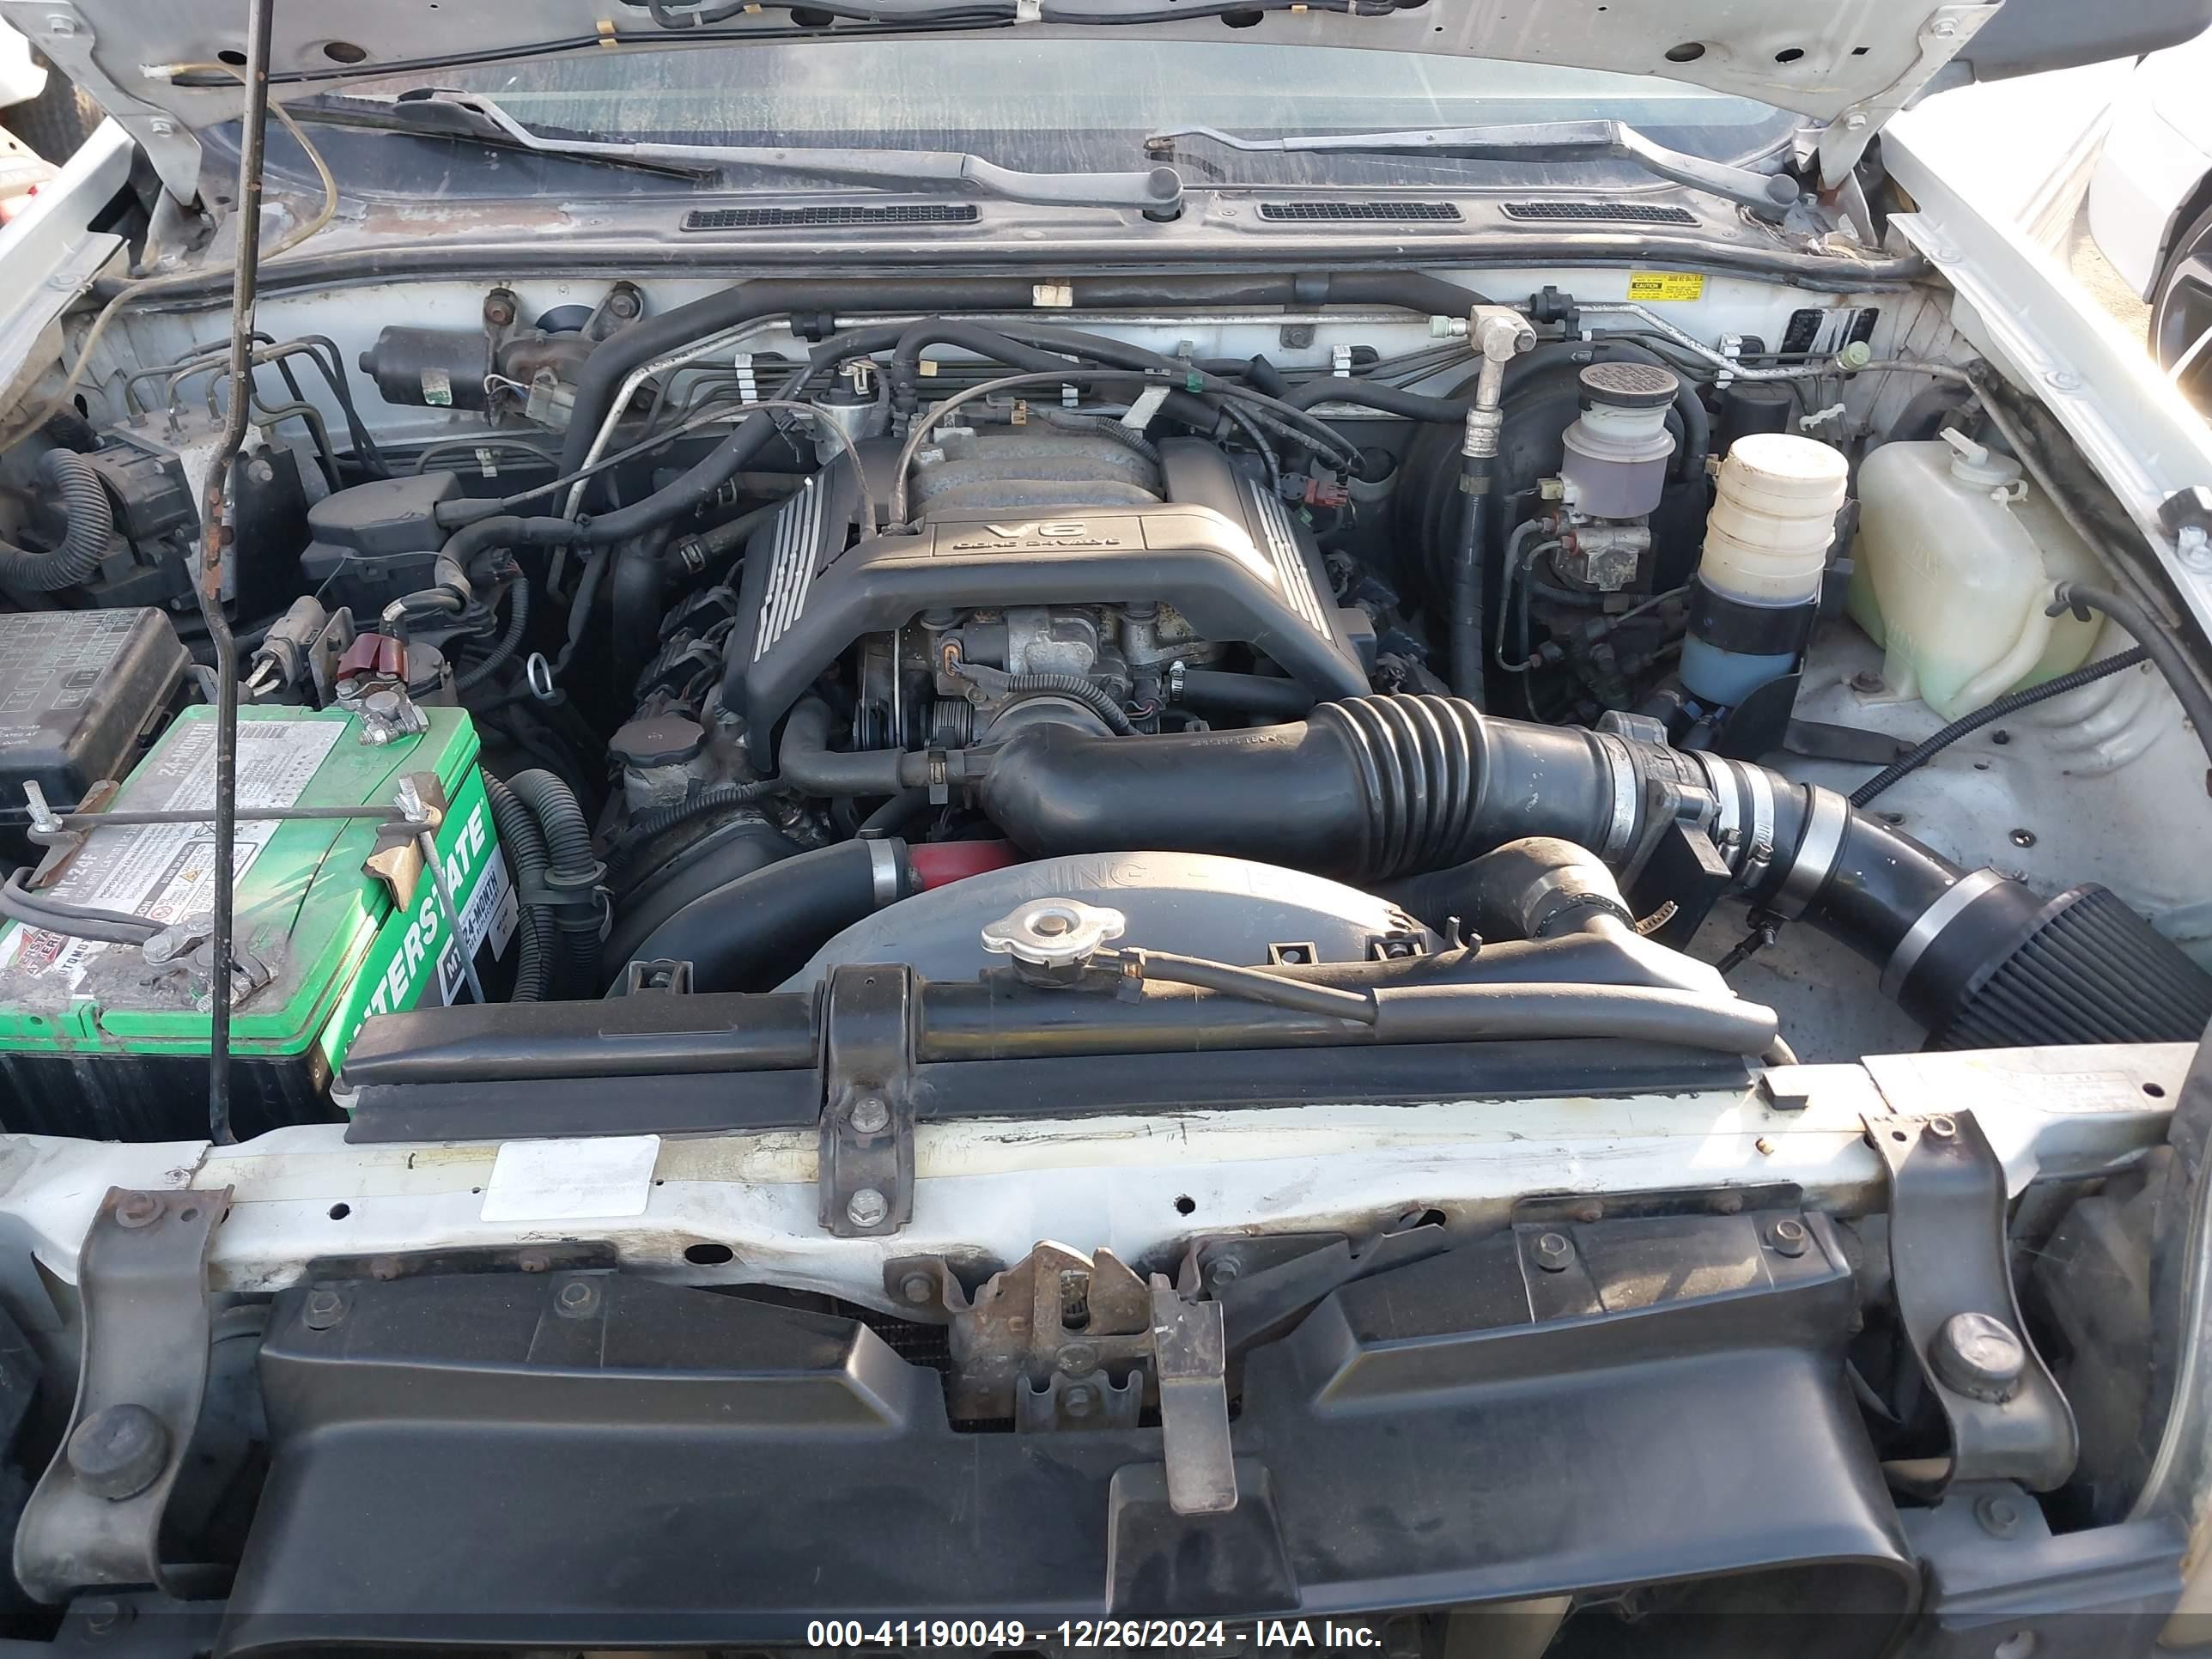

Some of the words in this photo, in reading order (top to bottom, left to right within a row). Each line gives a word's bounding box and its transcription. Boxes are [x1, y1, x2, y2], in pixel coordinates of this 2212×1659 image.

[984, 522, 1085, 539] V6
[49, 853, 99, 896] MT-24F
[345, 805, 487, 1054] TERSTATE
[461, 870, 499, 944] 24-MONTH
